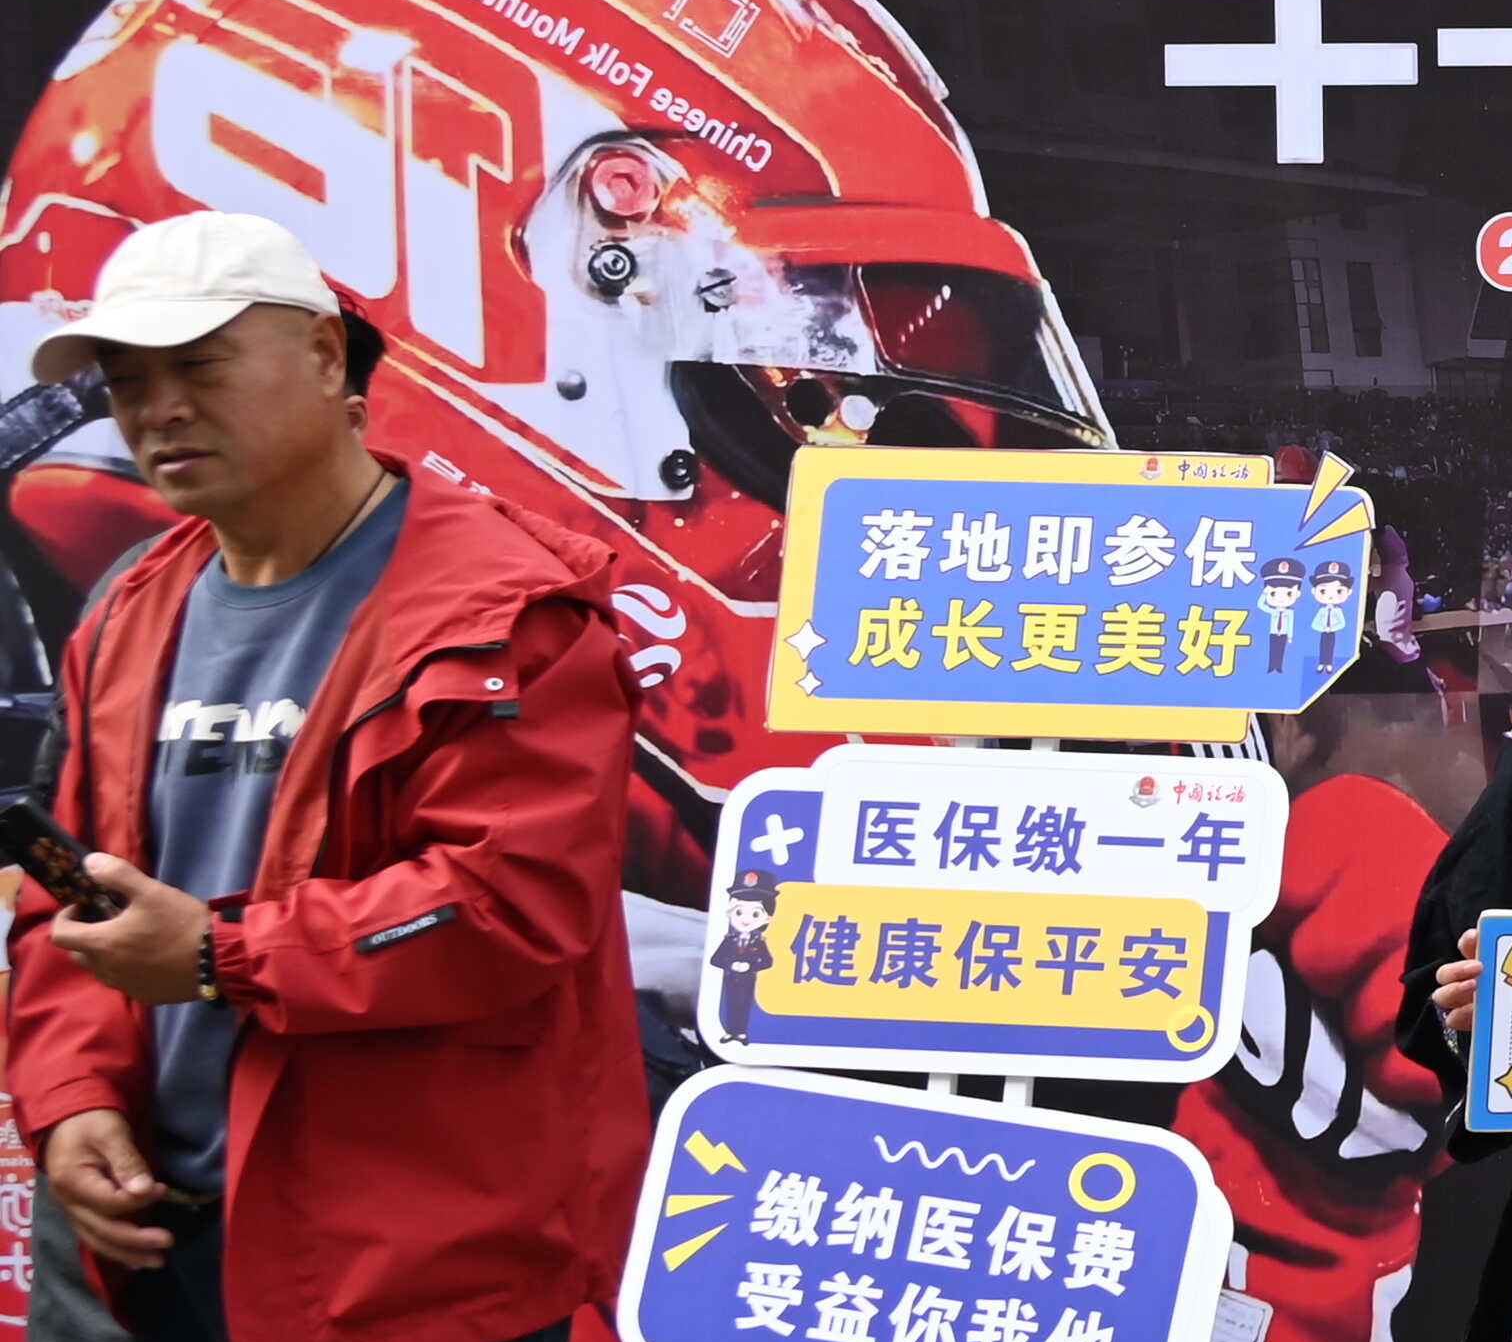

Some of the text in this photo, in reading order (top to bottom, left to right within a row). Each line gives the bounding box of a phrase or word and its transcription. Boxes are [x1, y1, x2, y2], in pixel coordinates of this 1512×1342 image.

[858, 508, 1259, 589] 落地即参保
[847, 596, 1254, 678] 成长更美好
[852, 799, 1247, 882] 医保缴一年
[789, 912, 1189, 1002] 健康保平安
[748, 1169, 1137, 1297] 缴纳医保费
